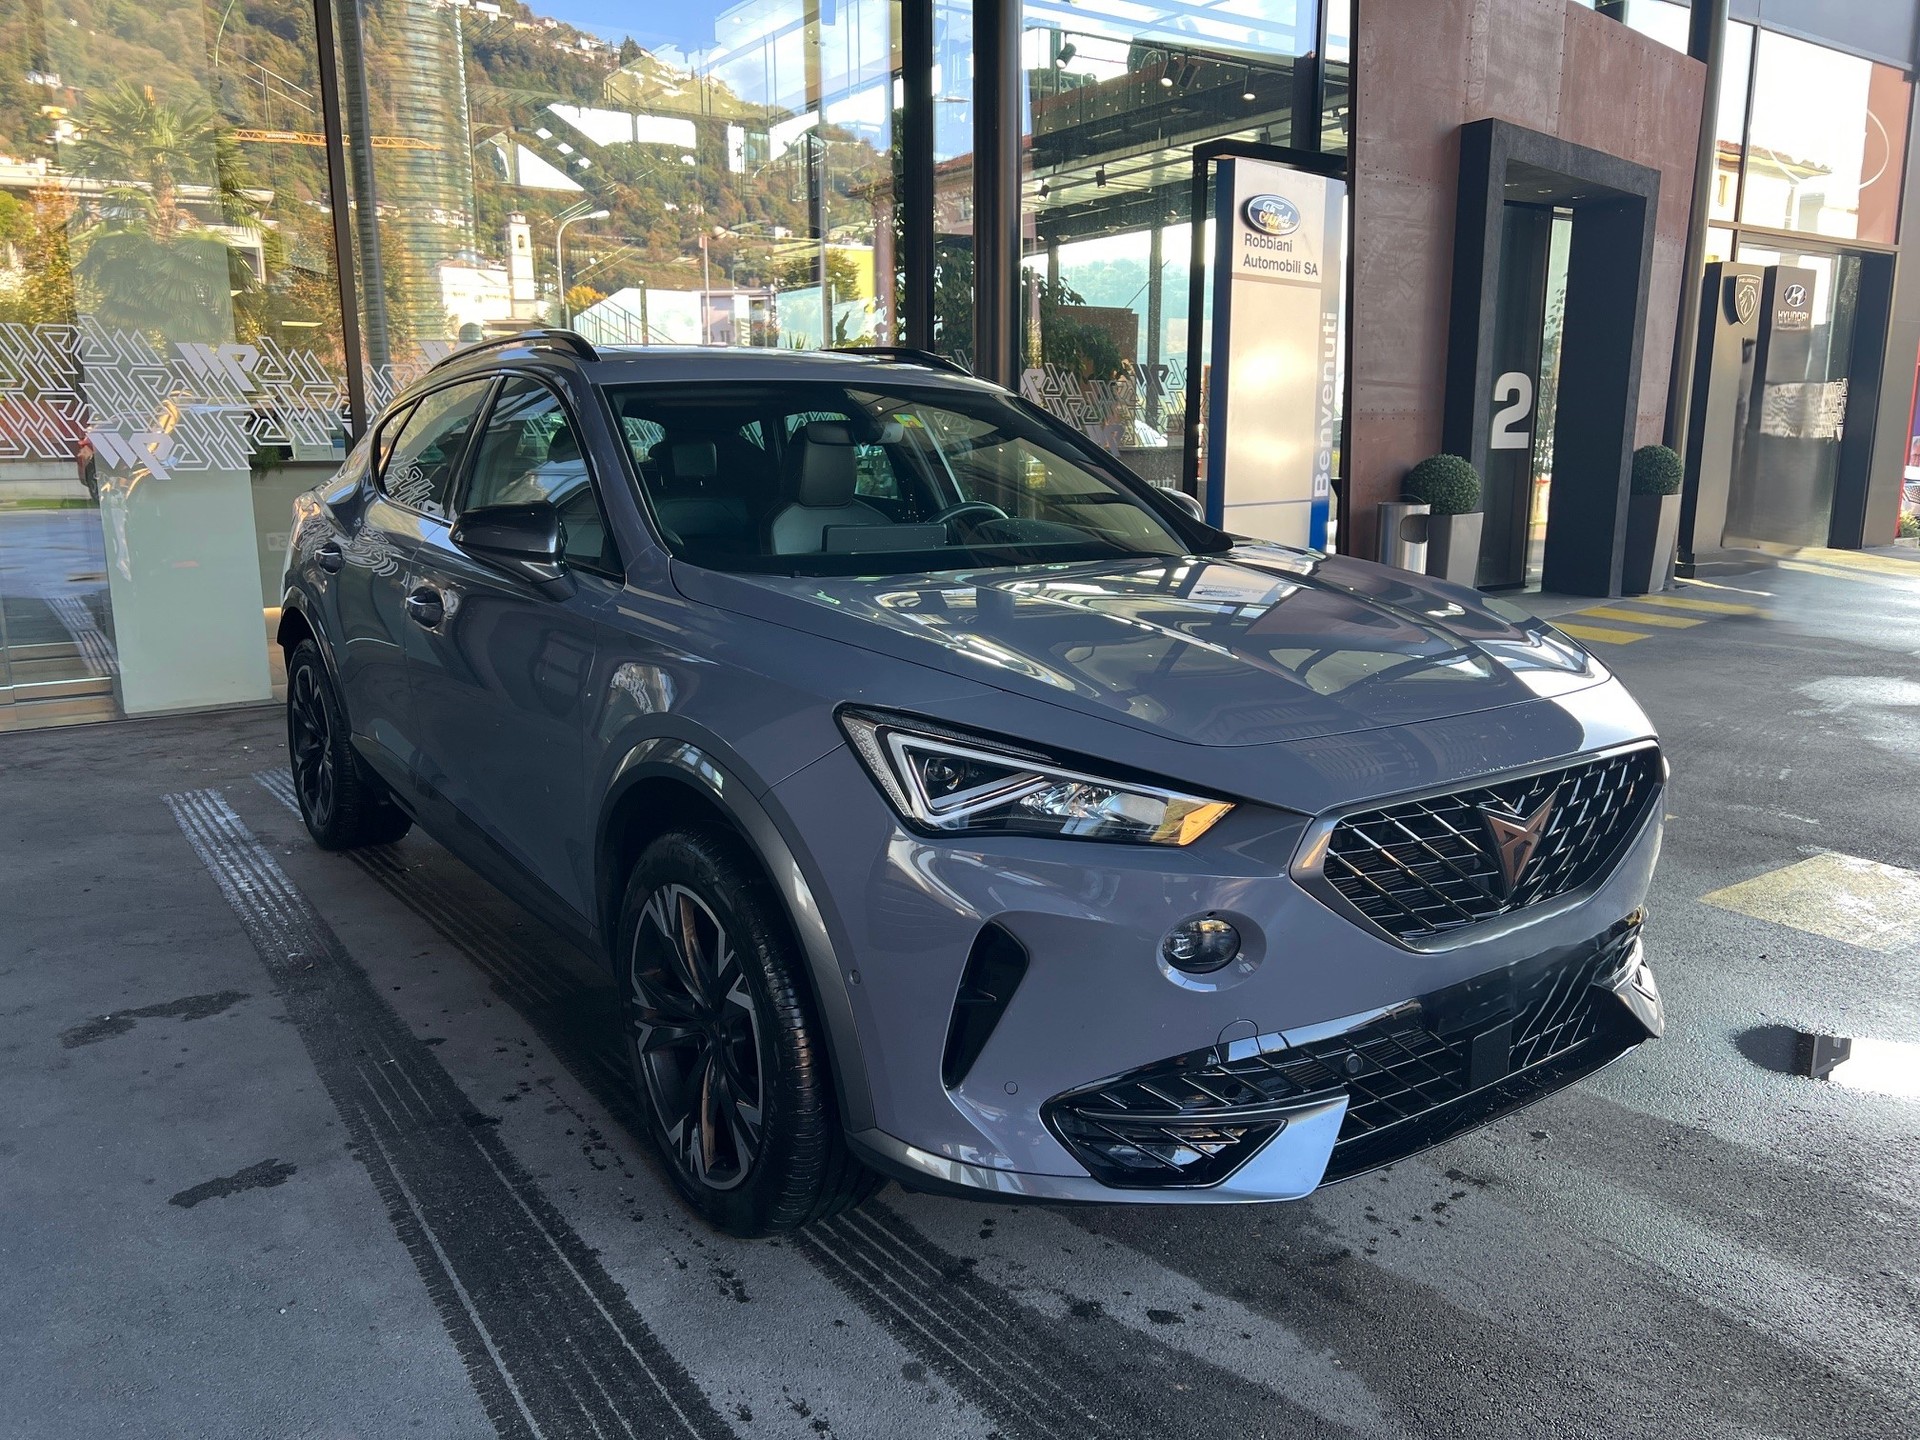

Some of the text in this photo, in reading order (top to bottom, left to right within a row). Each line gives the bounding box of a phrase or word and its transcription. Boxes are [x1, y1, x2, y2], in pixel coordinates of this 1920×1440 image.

[1244, 233, 1293, 252] Robbiani
[1243, 254, 1319, 276] Automobili SA
[1777, 310, 1810, 322] HYUNDAI
[1314, 311, 1337, 498] Benvenuti
[1490, 371, 1533, 450] 2
